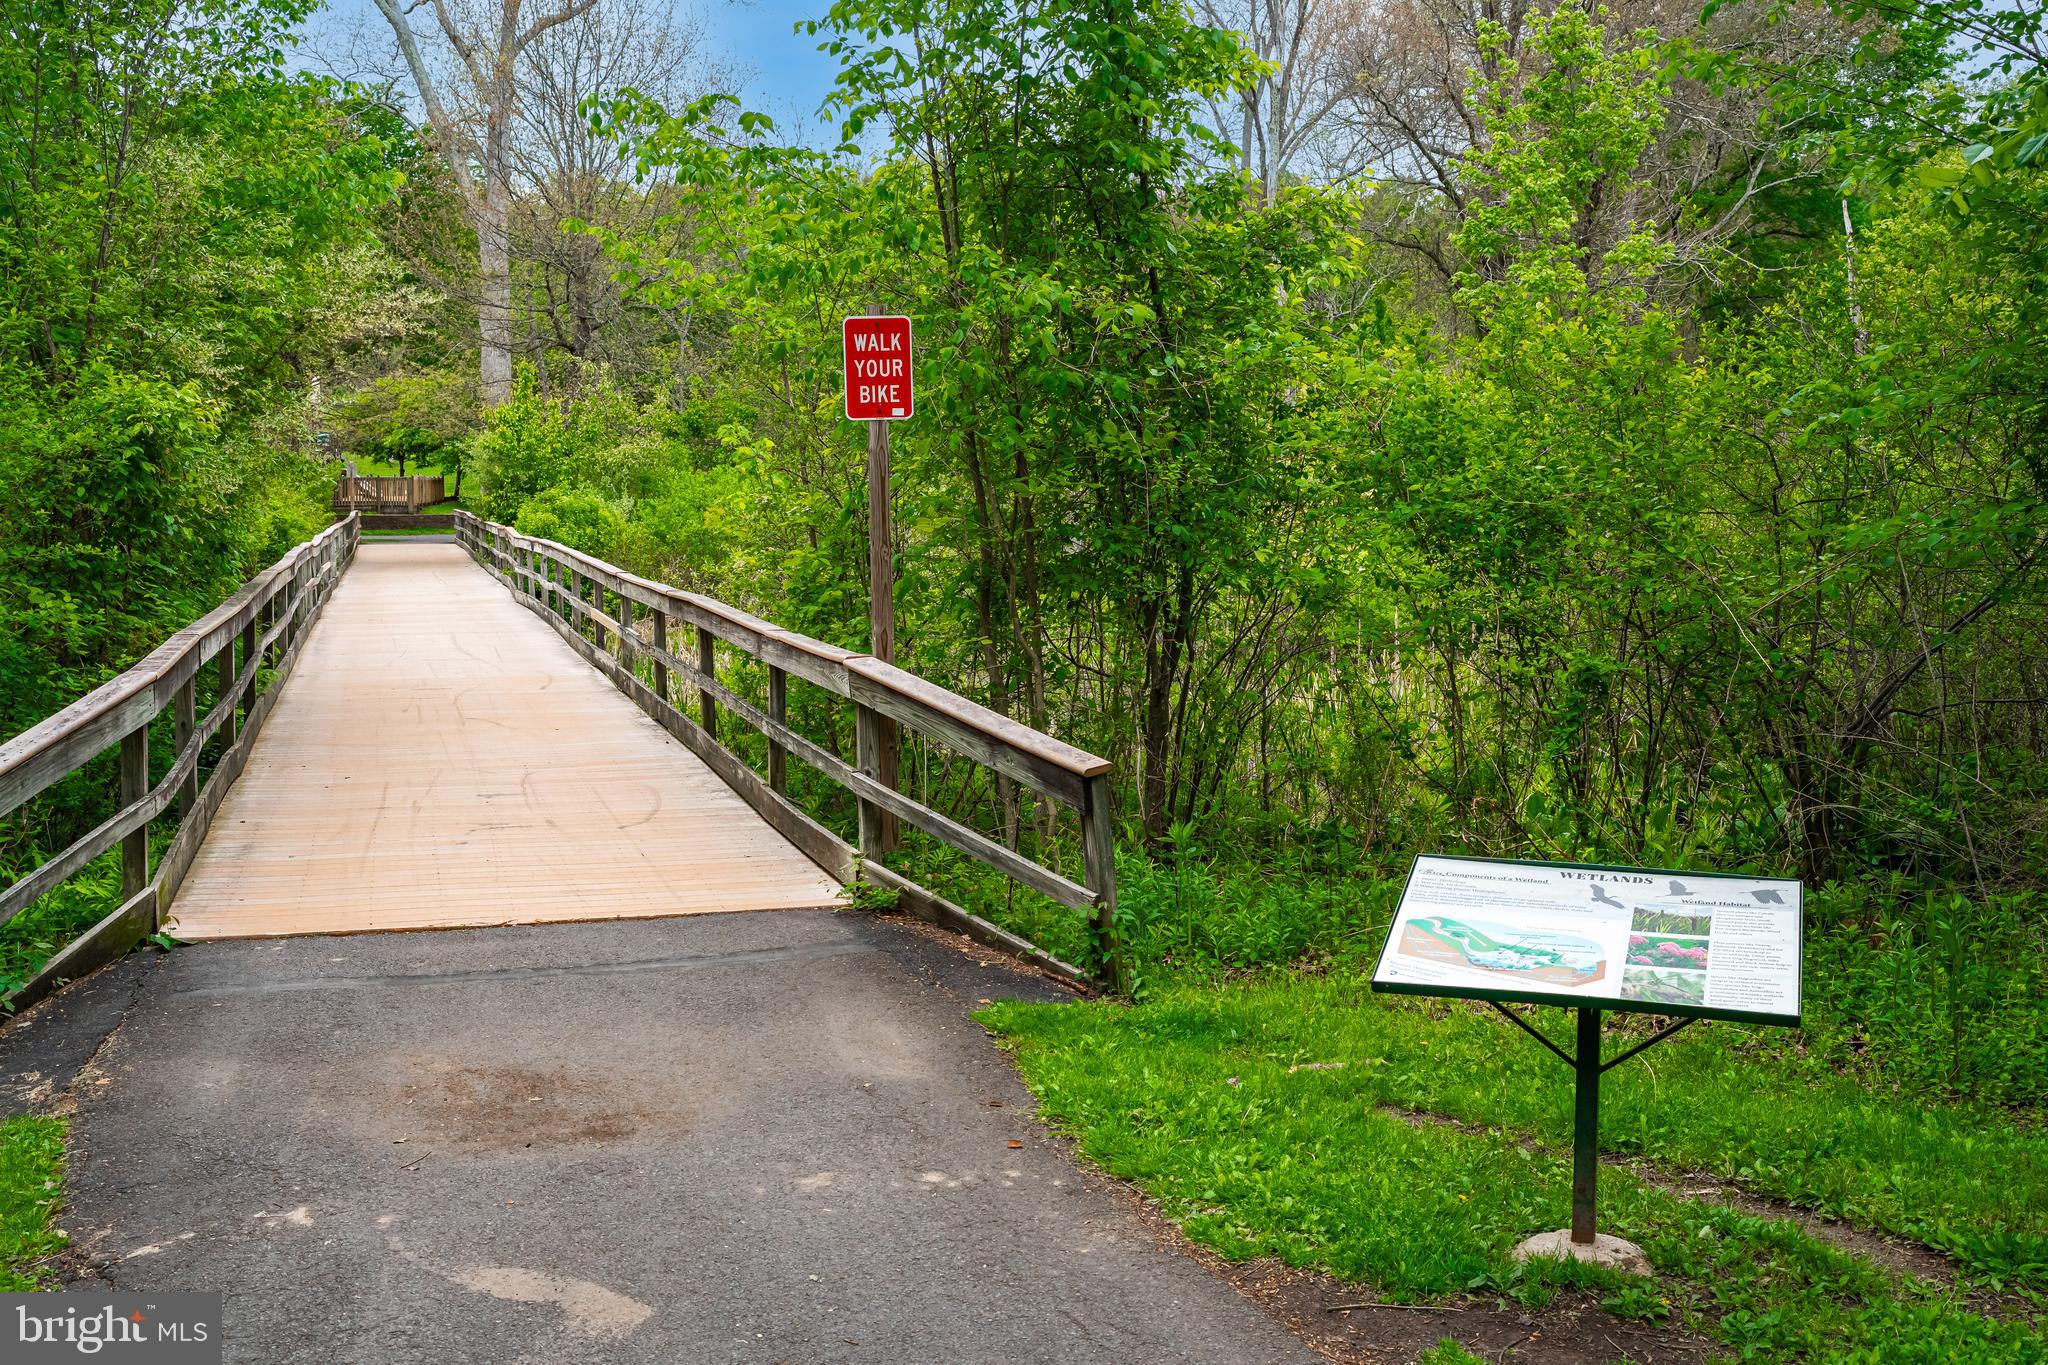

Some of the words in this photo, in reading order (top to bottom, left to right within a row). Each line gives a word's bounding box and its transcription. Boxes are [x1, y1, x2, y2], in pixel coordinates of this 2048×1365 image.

[854, 333, 902, 352] WALK
[854, 359, 903, 378] YOUR
[860, 385, 900, 404] BIKE
[1446, 872, 1496, 881] Components
[1560, 871, 1654, 885] WETLANDS
